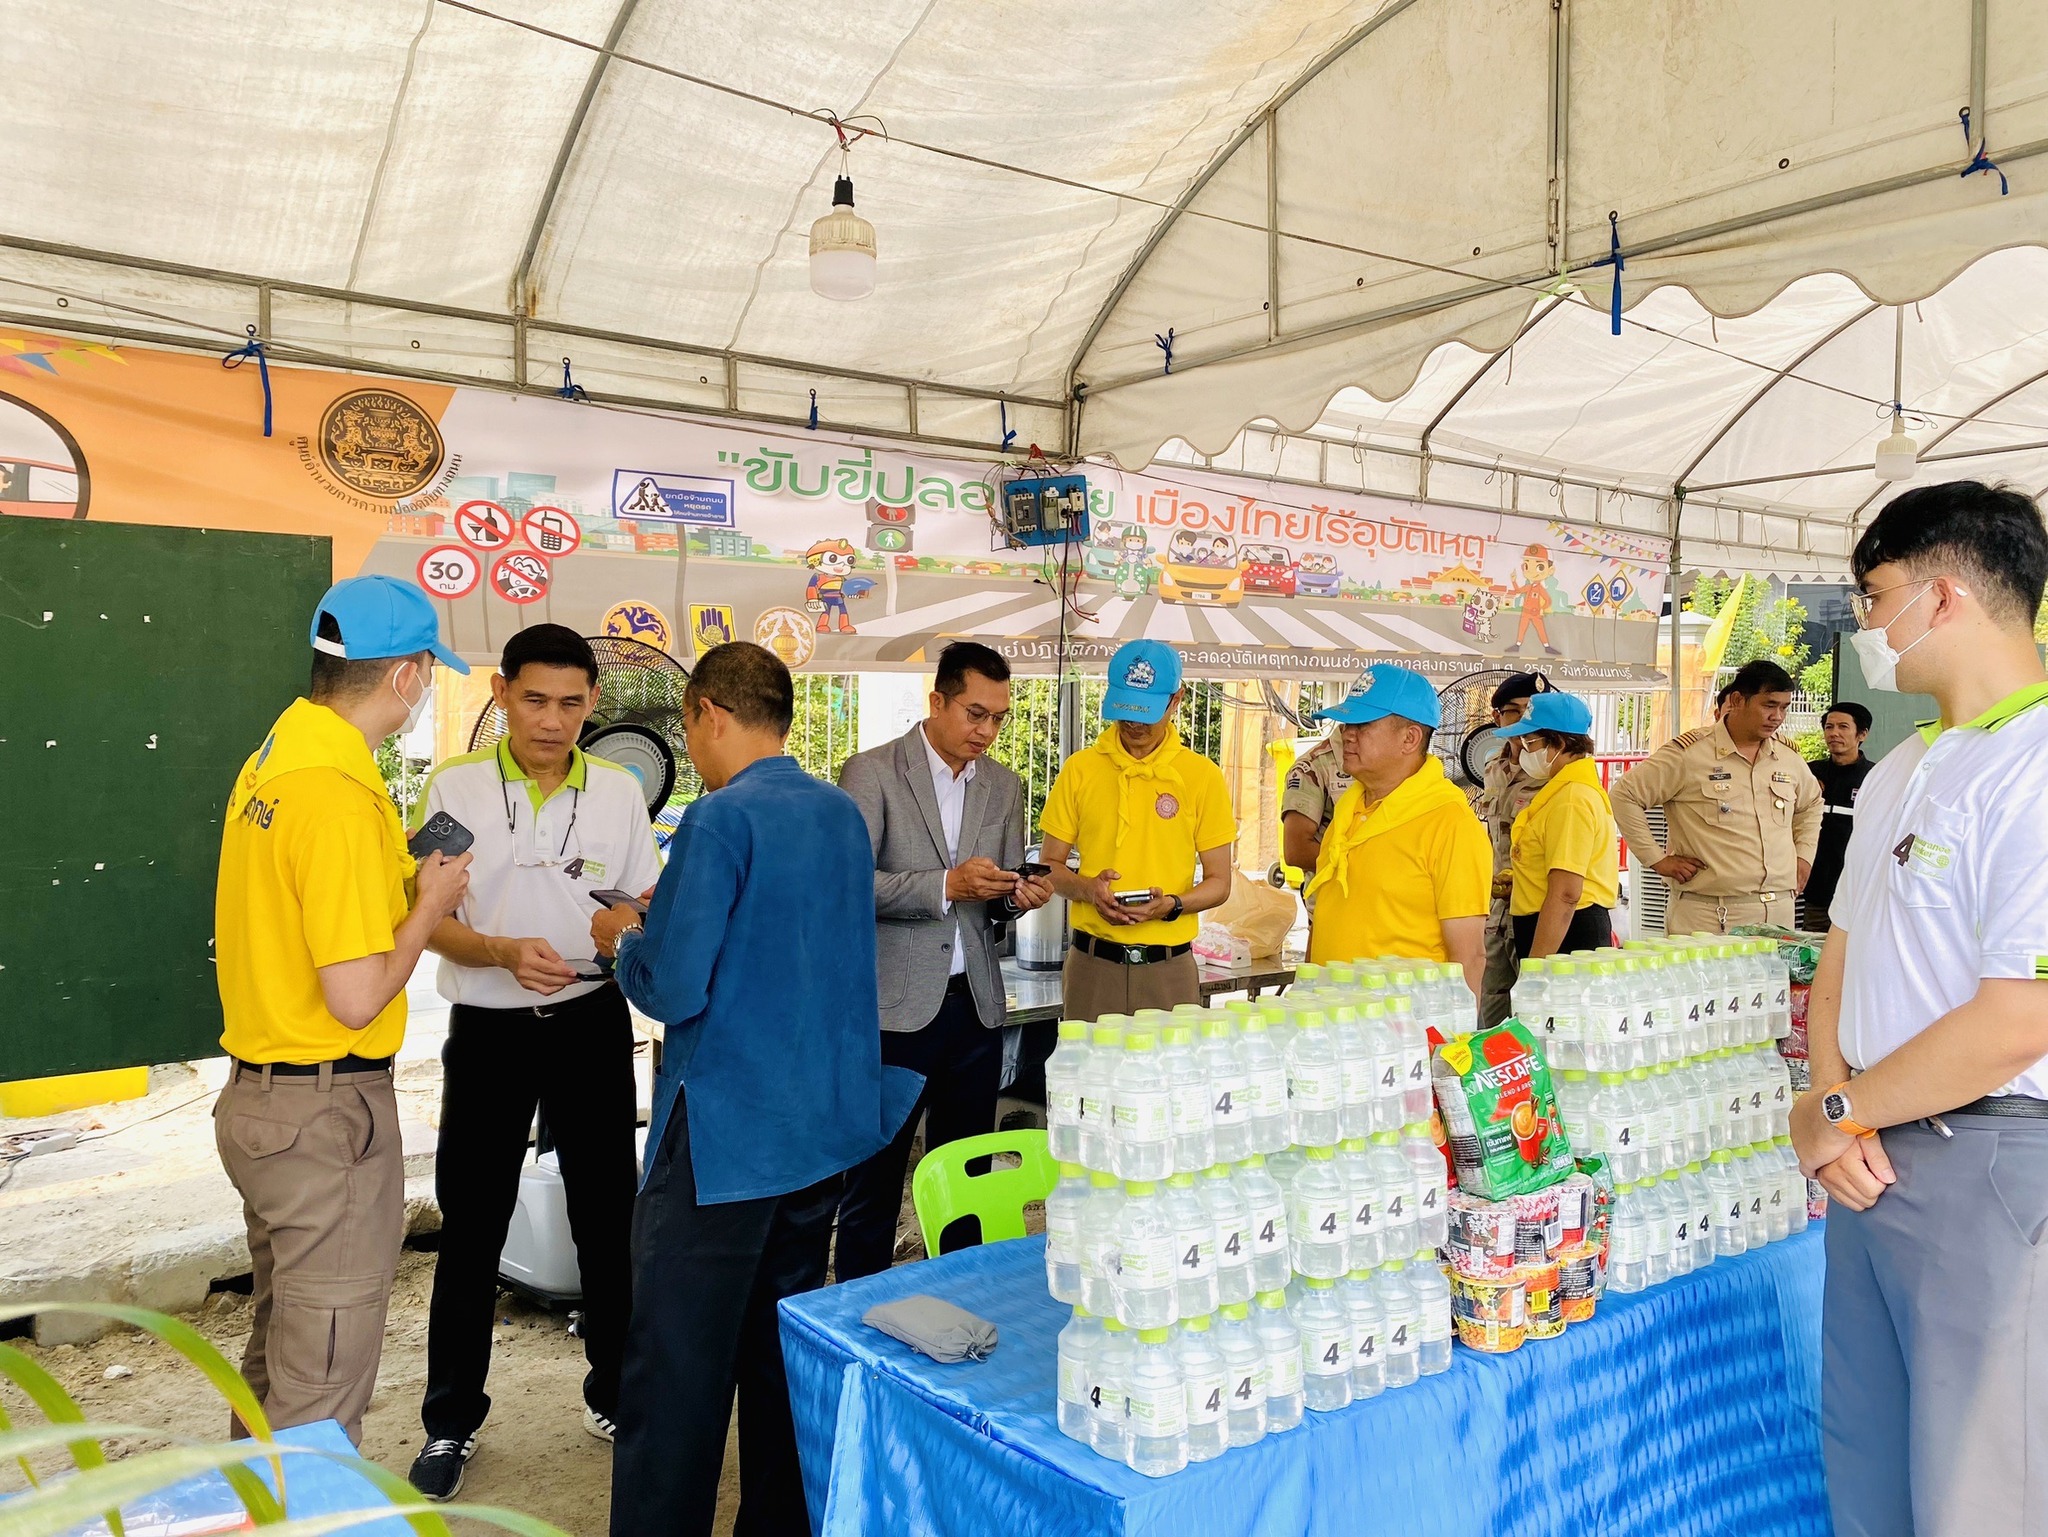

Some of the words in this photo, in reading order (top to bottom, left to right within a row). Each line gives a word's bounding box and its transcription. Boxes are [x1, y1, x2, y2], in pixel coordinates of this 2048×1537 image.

[717, 446, 1115, 519] "ขับขี่ปลอย
[1136, 488, 1499, 569] เมืองไทยไร้อุบัติเหตุ"
[428, 561, 464, 581] 30
[1524, 663, 1553, 675] 2567
[1560, 666, 1633, 680] จังหวัดนนทบุรี
[1892, 832, 1916, 867] 4
[563, 857, 585, 880] 4
[1727, 996, 1740, 1013] 4
[1751, 992, 1763, 1008] 4
[1775, 989, 1786, 1005] 4
[1688, 1004, 1700, 1021] 4
[1704, 999, 1716, 1016] 4
[1545, 1016, 1556, 1033] 4
[1618, 1016, 1629, 1034] 4
[1643, 1011, 1654, 1028] 4
[1381, 1066, 1396, 1086] 4
[1410, 1060, 1425, 1080] 4
[1215, 1092, 1233, 1114] 4
[1750, 1091, 1762, 1108] 4
[1774, 1085, 1785, 1101] 4
[1729, 1097, 1741, 1113] 4
[1618, 1127, 1631, 1145] 4
[1388, 1196, 1403, 1216] 4
[1422, 1187, 1436, 1208] 4
[1750, 1197, 1762, 1214] 4
[1770, 1189, 1782, 1206] 4
[1356, 1203, 1372, 1224] 4
[1729, 1201, 1741, 1218] 4
[1259, 1219, 1276, 1242] 4
[1319, 1212, 1337, 1234] 4
[1677, 1222, 1688, 1240] 4
[1699, 1214, 1710, 1231] 4
[1224, 1232, 1241, 1255] 4
[1182, 1244, 1200, 1268] 4
[1391, 1324, 1408, 1345] 4
[1323, 1342, 1340, 1364] 4
[1358, 1335, 1375, 1355] 4
[1235, 1376, 1252, 1400] 4
[1205, 1387, 1221, 1411] 4
